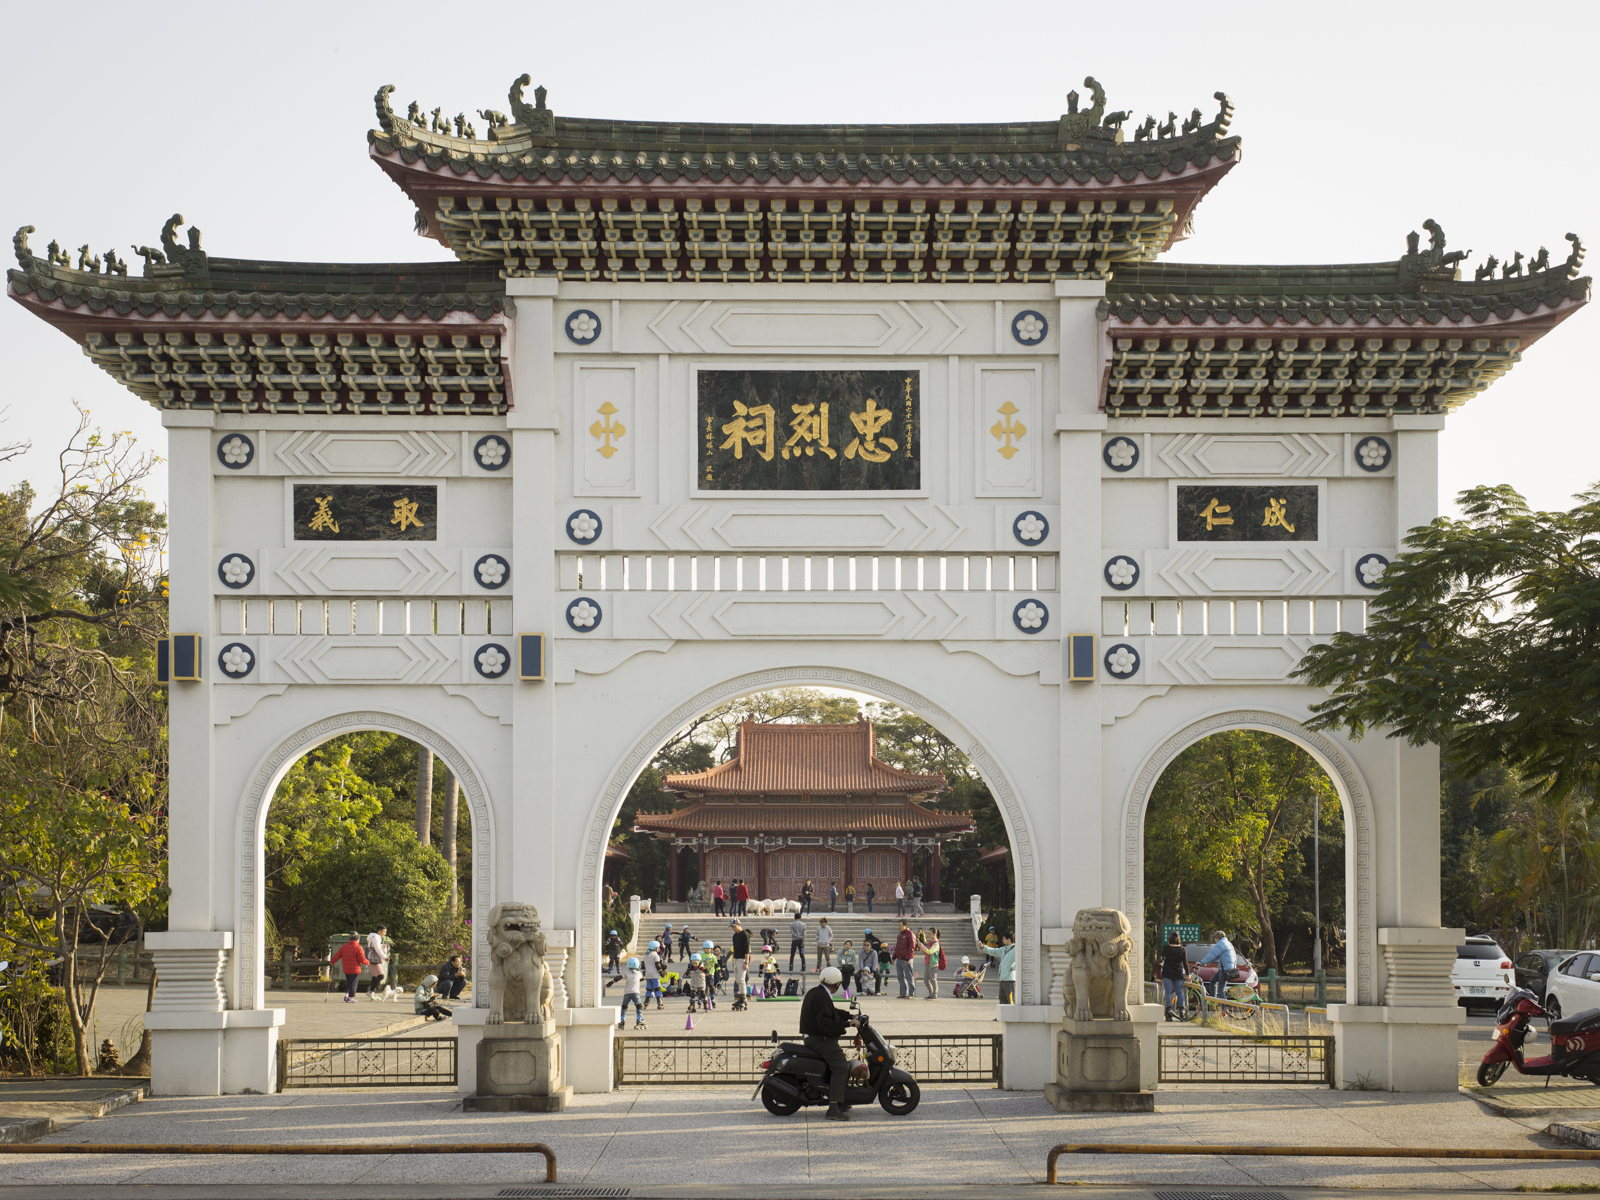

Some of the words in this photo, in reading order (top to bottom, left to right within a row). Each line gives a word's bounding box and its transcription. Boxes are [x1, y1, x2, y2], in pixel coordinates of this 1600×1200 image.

[718, 398, 899, 463] 忠烈祠
[308, 495, 425, 534] 取義
[1199, 497, 1296, 533] 成仁
